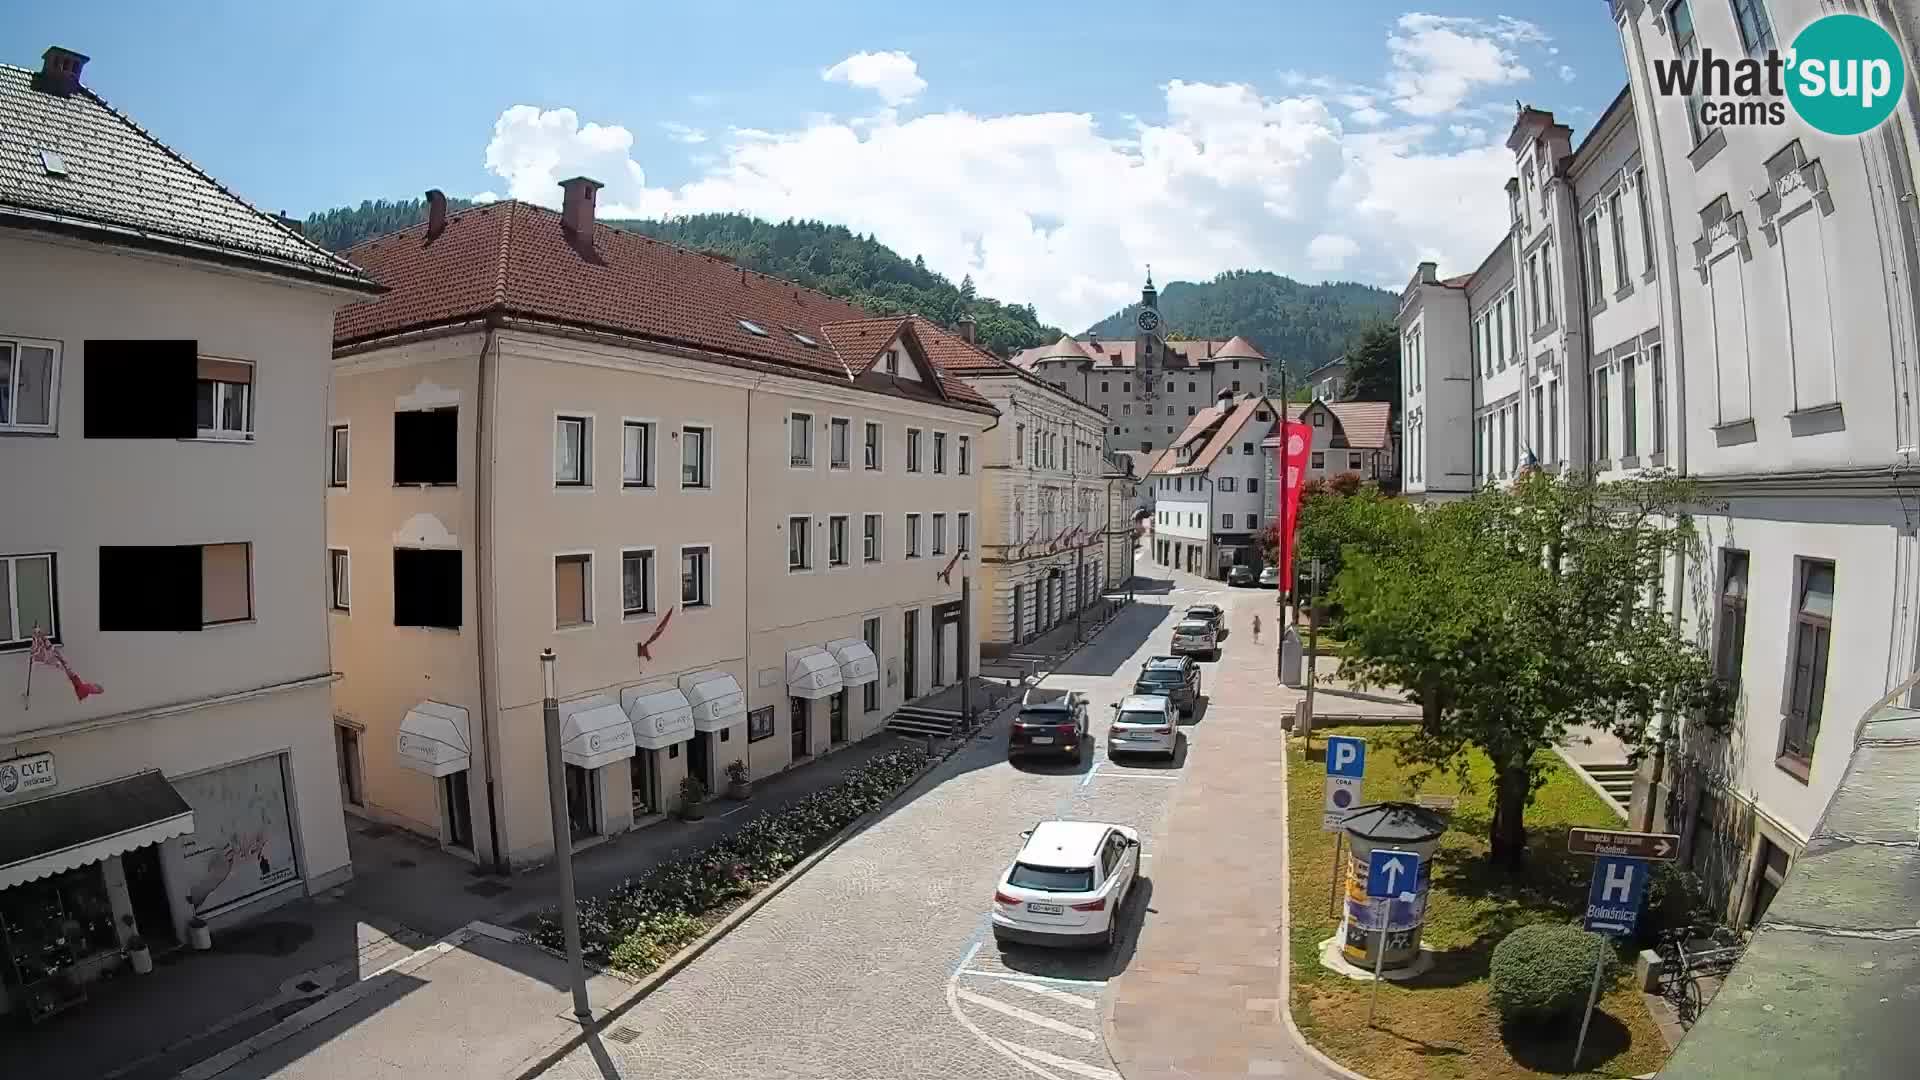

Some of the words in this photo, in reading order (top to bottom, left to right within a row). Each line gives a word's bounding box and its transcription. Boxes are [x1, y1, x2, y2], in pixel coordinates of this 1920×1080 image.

[22, 760, 49, 776] CVET
[1335, 743, 1356, 771] P
[1602, 863, 1634, 902] H
